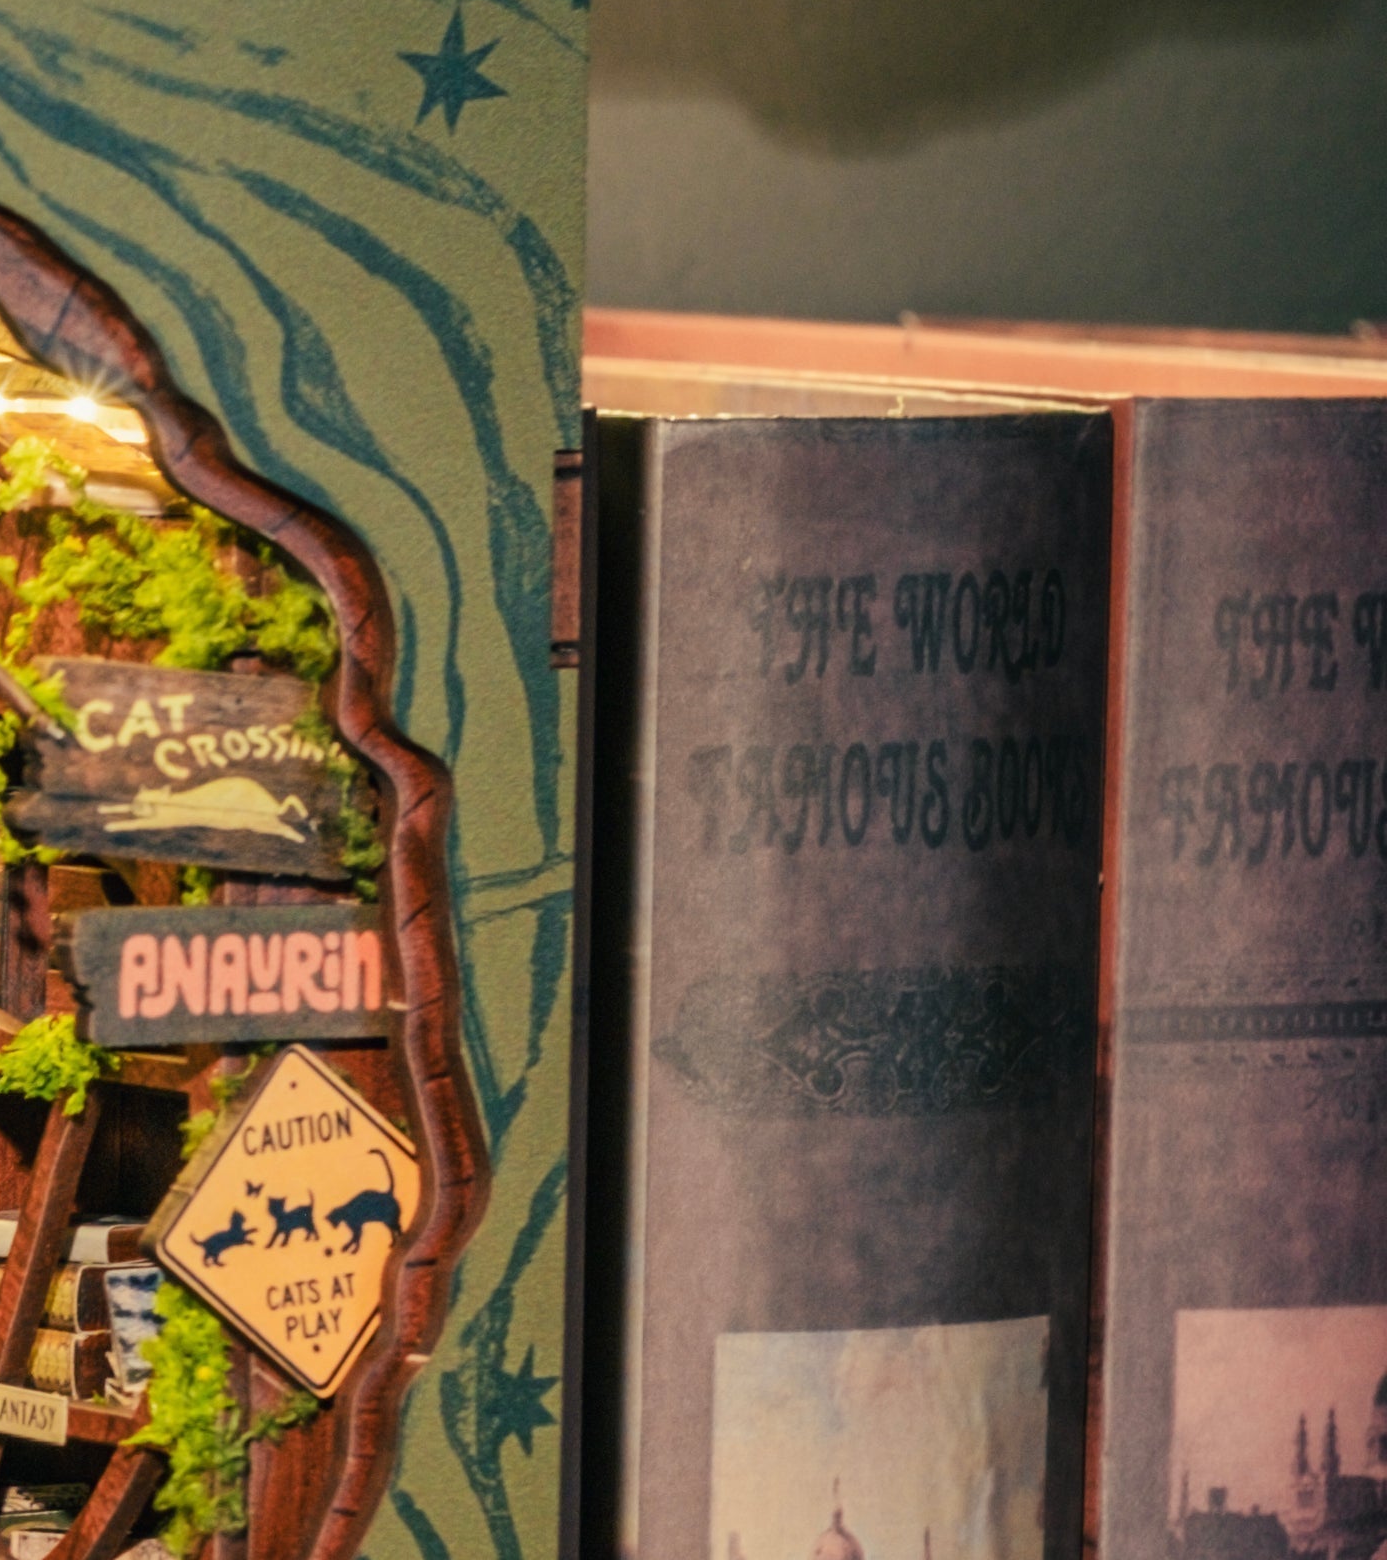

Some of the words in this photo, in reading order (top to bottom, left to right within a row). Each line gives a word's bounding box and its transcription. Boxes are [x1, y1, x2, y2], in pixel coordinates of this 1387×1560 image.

[747, 573, 877, 685] THE
[892, 567, 1067, 684] WORLD
[1214, 589, 1340, 700] THE
[76, 694, 194, 753] CAT
[686, 740, 951, 855] FAMOUS
[241, 1104, 353, 1157] CAUTION
[266, 1276, 325, 1313] CATS
[331, 1273, 356, 1306] AT
[284, 1307, 343, 1342] PLAY
